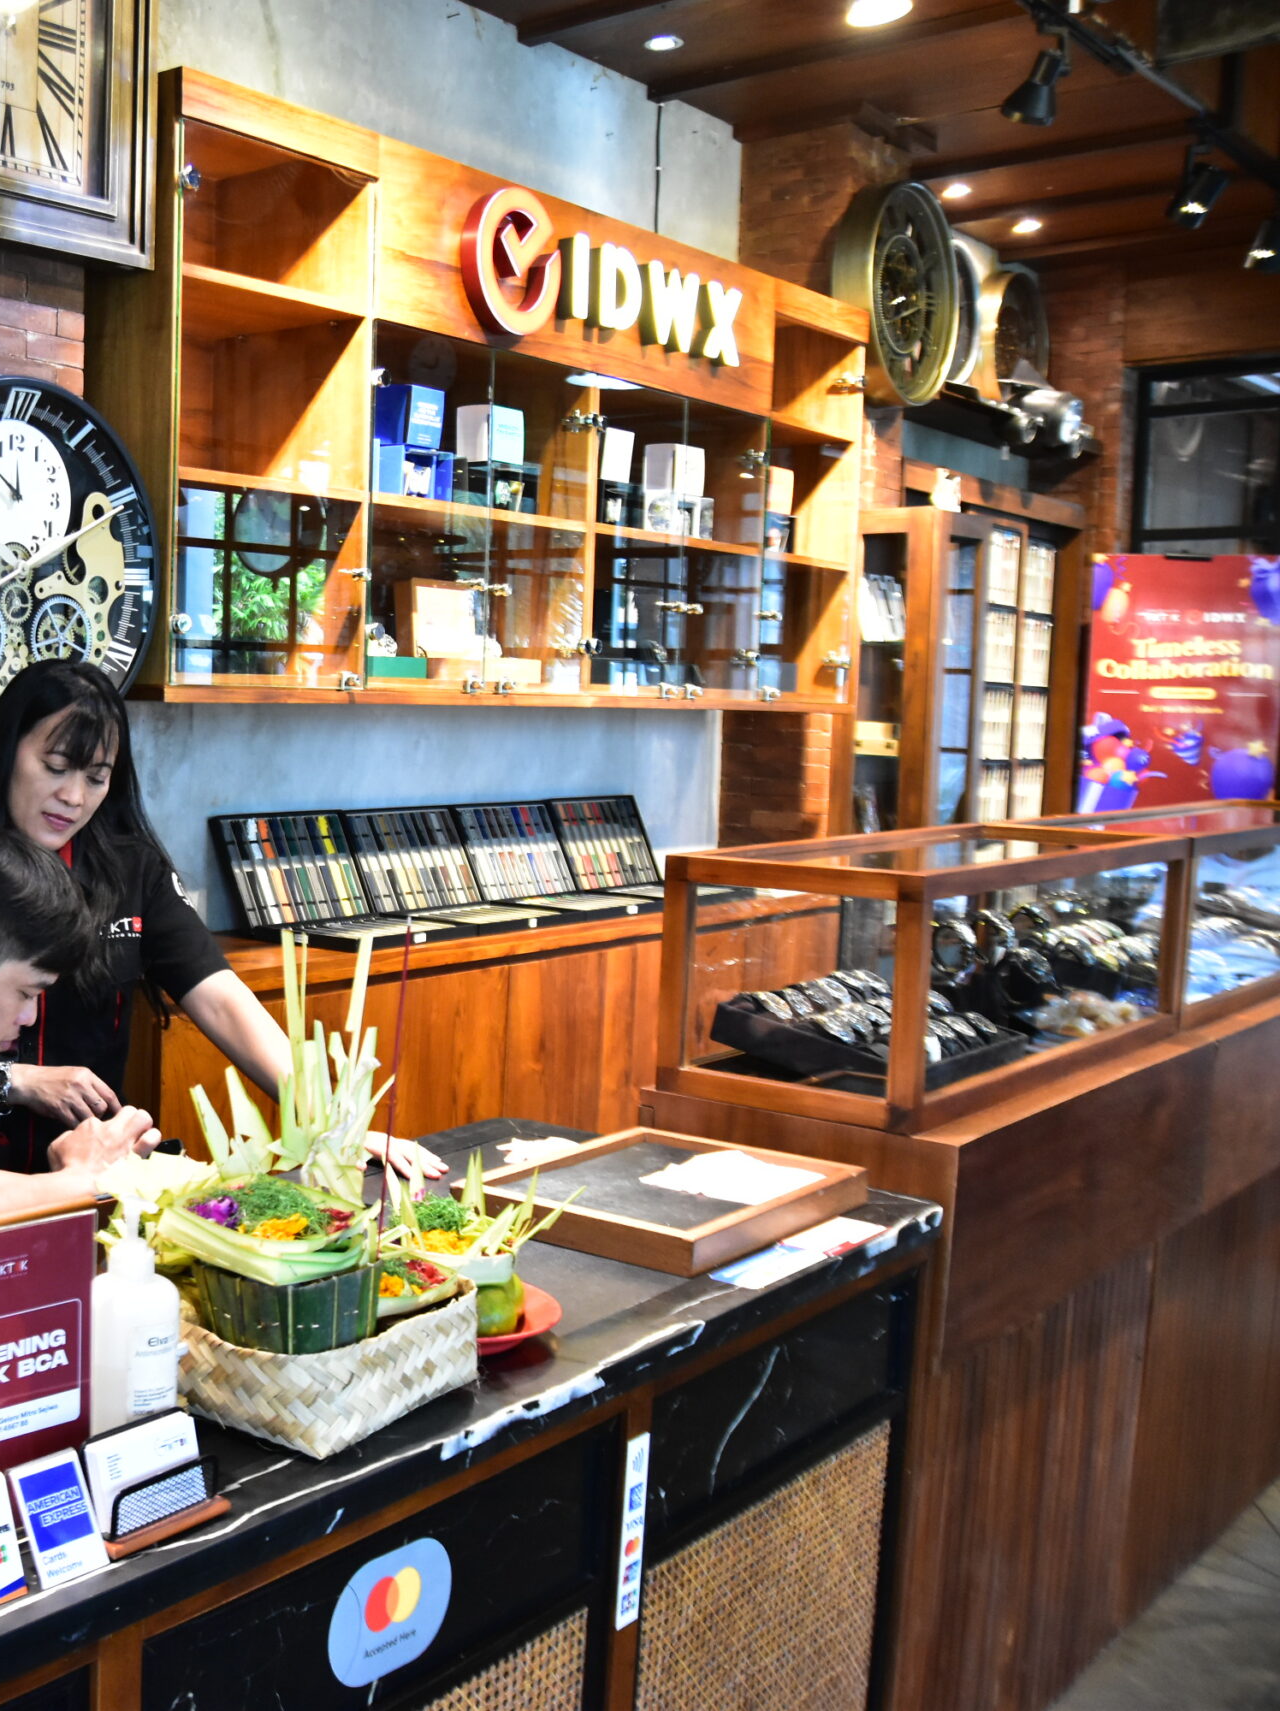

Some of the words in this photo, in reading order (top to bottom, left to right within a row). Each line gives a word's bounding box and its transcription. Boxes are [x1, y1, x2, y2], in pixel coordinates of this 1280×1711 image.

[565, 231, 743, 367] IDWX
[9, 433, 24, 452] 12
[1131, 636, 1242, 659] Timeless
[1096, 657, 1275, 680] Collaboration
[17, 1349, 69, 1378] BCA
[27, 1486, 80, 1514] AMERICAN
[41, 1502, 88, 1527] EXPRESS
[42, 1551, 67, 1566] Cards
[46, 1559, 83, 1579] Welcome
[364, 1637, 398, 1659] Accepted
[400, 1629, 417, 1643] Here
